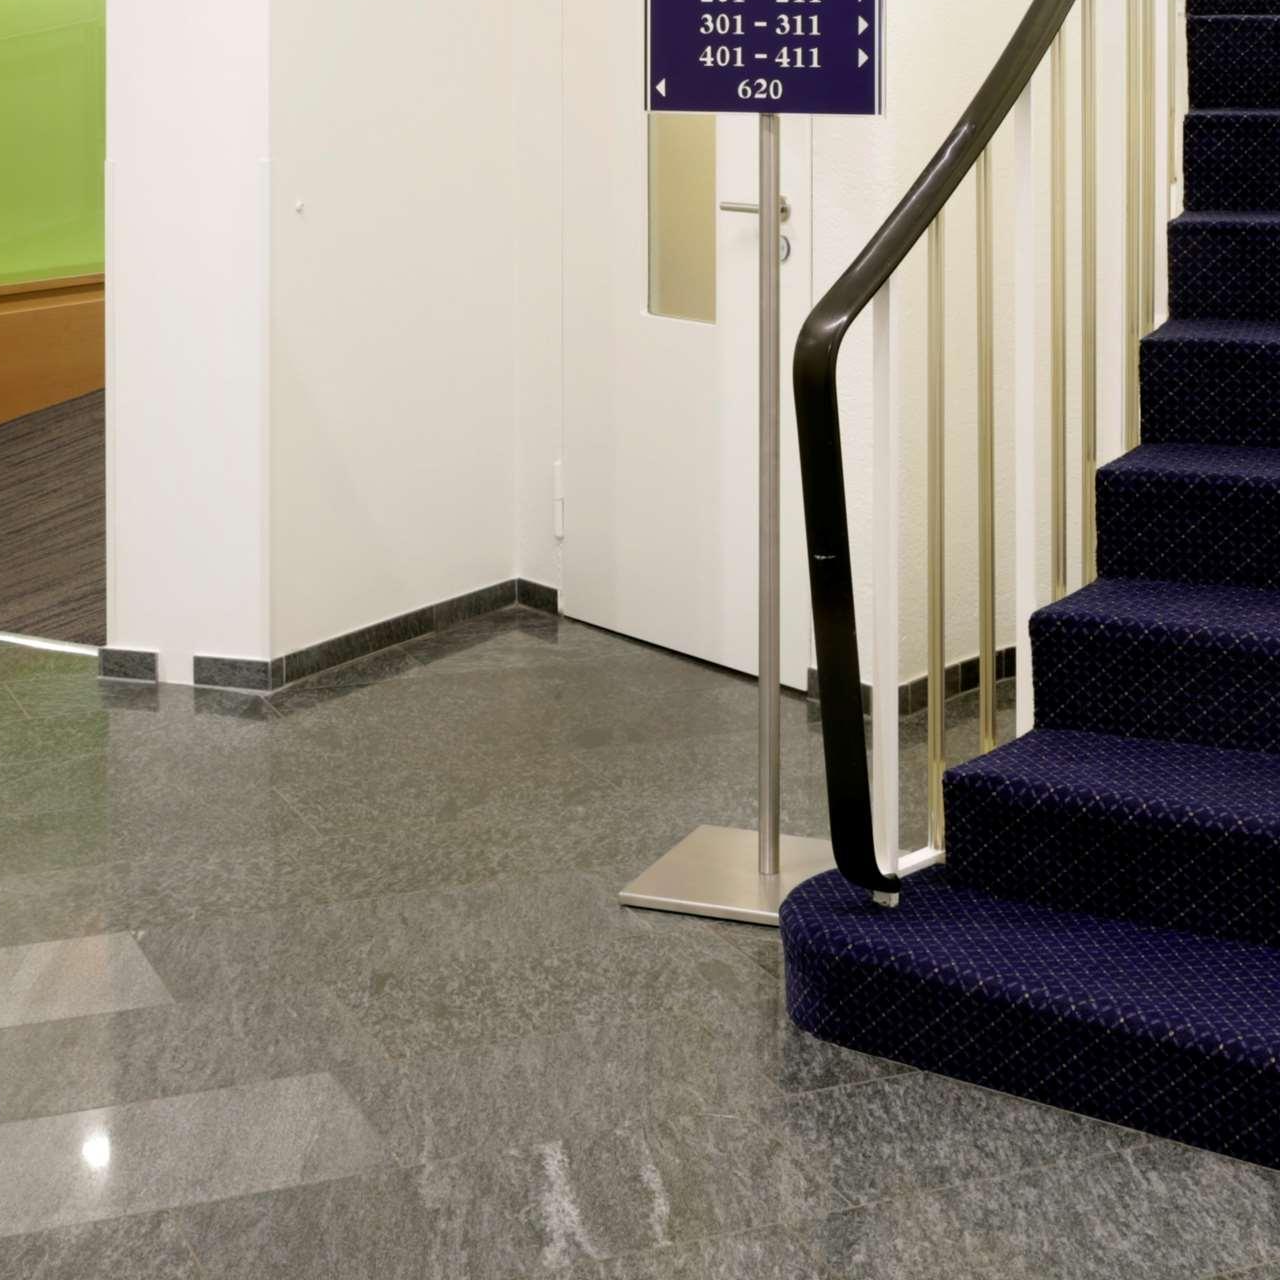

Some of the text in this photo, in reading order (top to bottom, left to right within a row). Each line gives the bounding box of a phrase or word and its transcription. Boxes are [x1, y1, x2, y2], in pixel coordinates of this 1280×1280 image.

[699, 13, 745, 36] 301
[775, 13, 821, 36] 311
[698, 45, 745, 68] 401
[774, 45, 821, 68] 411
[737, 78, 783, 100] 620
